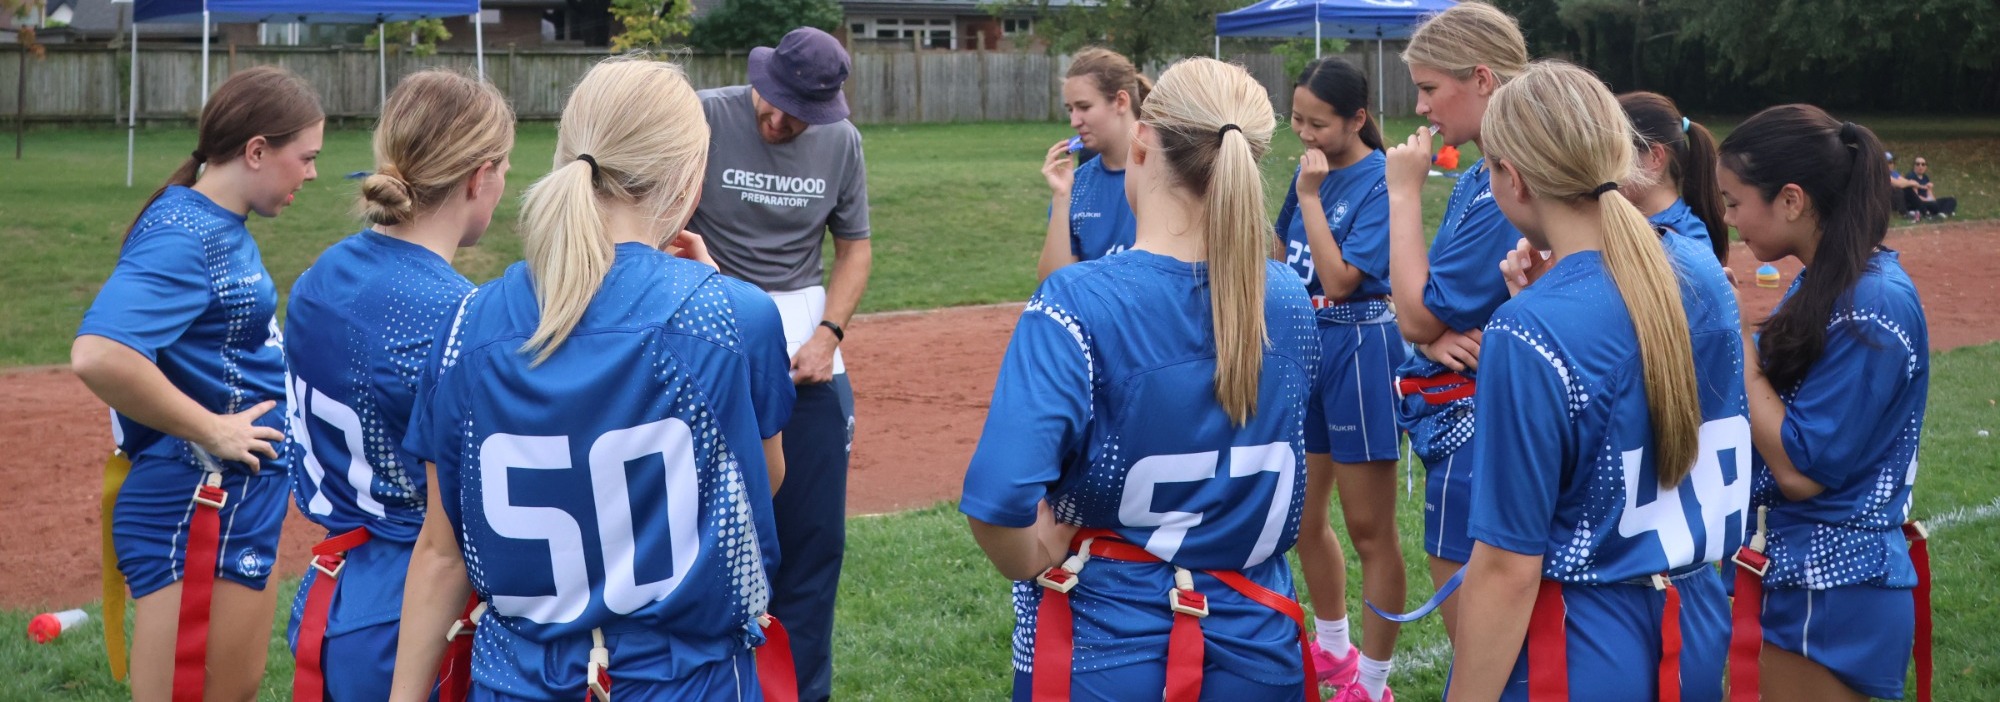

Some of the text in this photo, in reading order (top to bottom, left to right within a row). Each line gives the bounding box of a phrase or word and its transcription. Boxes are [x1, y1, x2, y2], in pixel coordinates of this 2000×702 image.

[722, 168, 826, 194] CRESTWOOD
[740, 191, 809, 207] PREPARATORY
[1286, 240, 1315, 285] 23
[480, 417, 700, 624] 50
